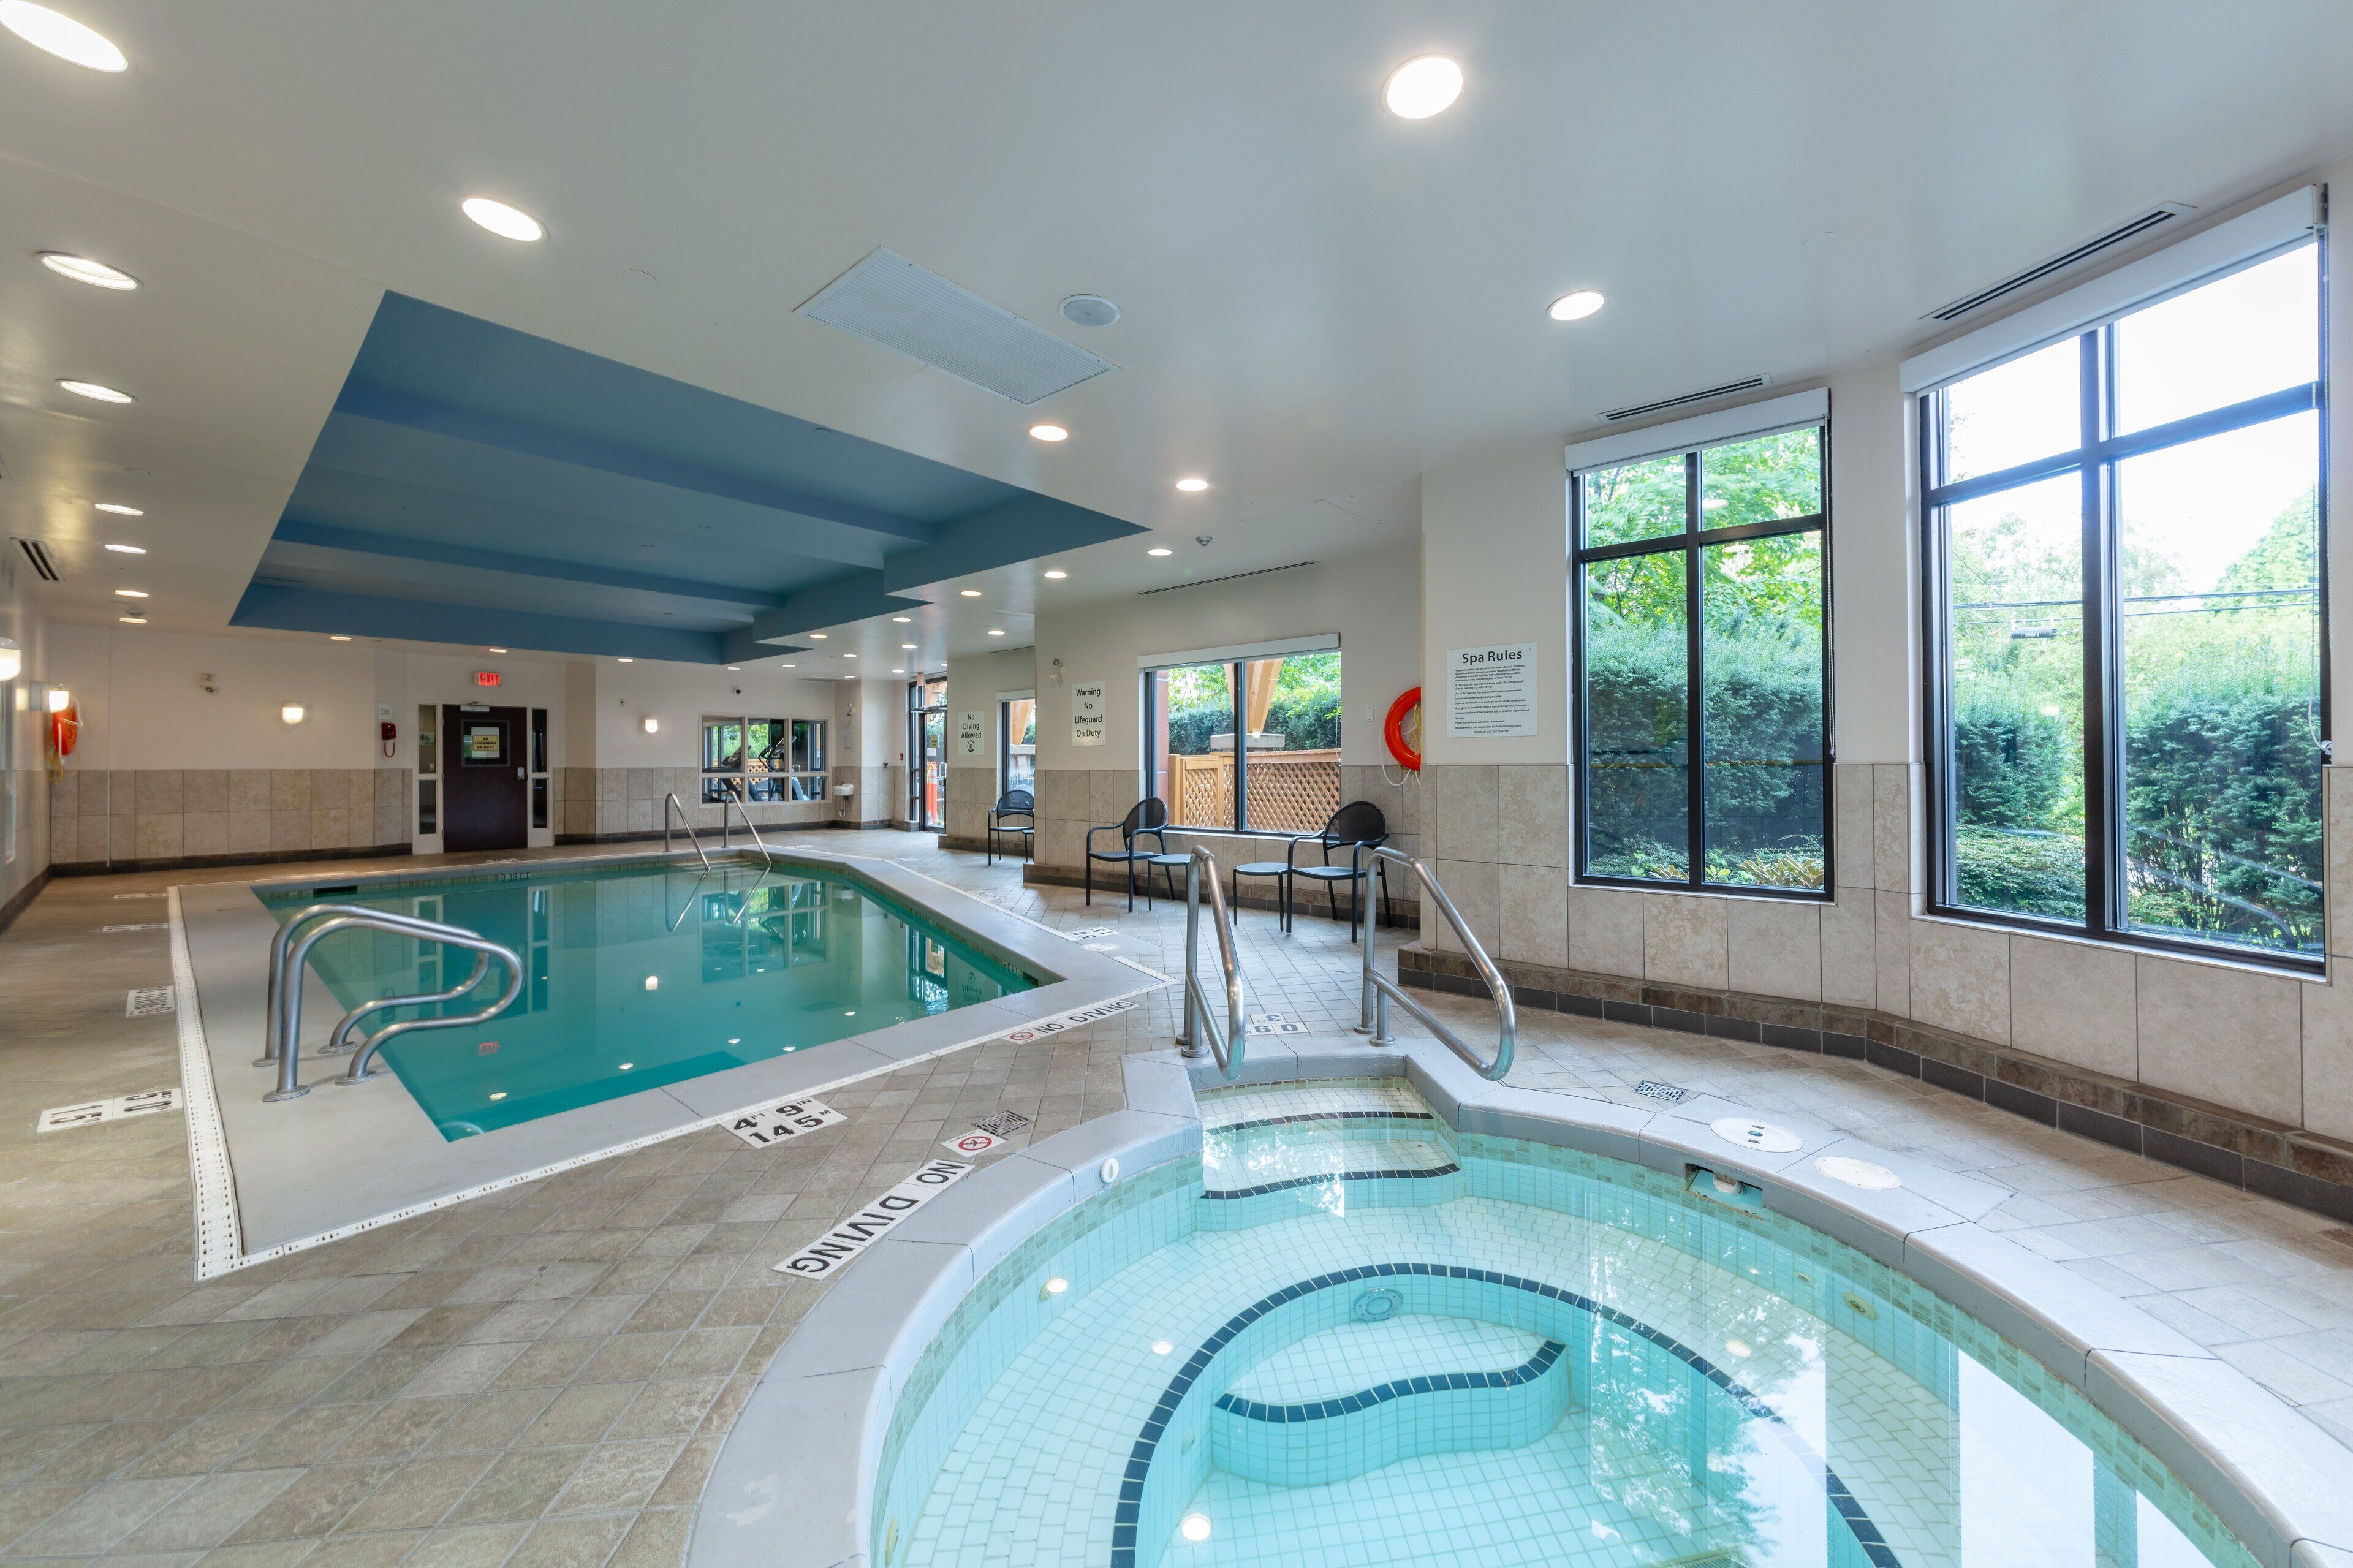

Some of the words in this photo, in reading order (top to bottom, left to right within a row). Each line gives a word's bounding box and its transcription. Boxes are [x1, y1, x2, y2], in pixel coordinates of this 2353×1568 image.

[1462, 653, 1484, 665] Spa
[1488, 650, 1522, 661] Rules
[479, 673, 499, 686] EXIT
[1076, 688, 1101, 697] Warning
[1075, 714, 1102, 724] Lifeguard
[1086, 729, 1101, 738] Duty
[1033, 1023, 1064, 1034] NO
[1067, 1001, 1133, 1023] DIVING
[733, 1118, 759, 1131] 4
[776, 1105, 805, 1116] 9
[947, 1134, 967, 1143] DIVING
[915, 1162, 966, 1184] NO
[786, 1195, 920, 1273] DIVING
